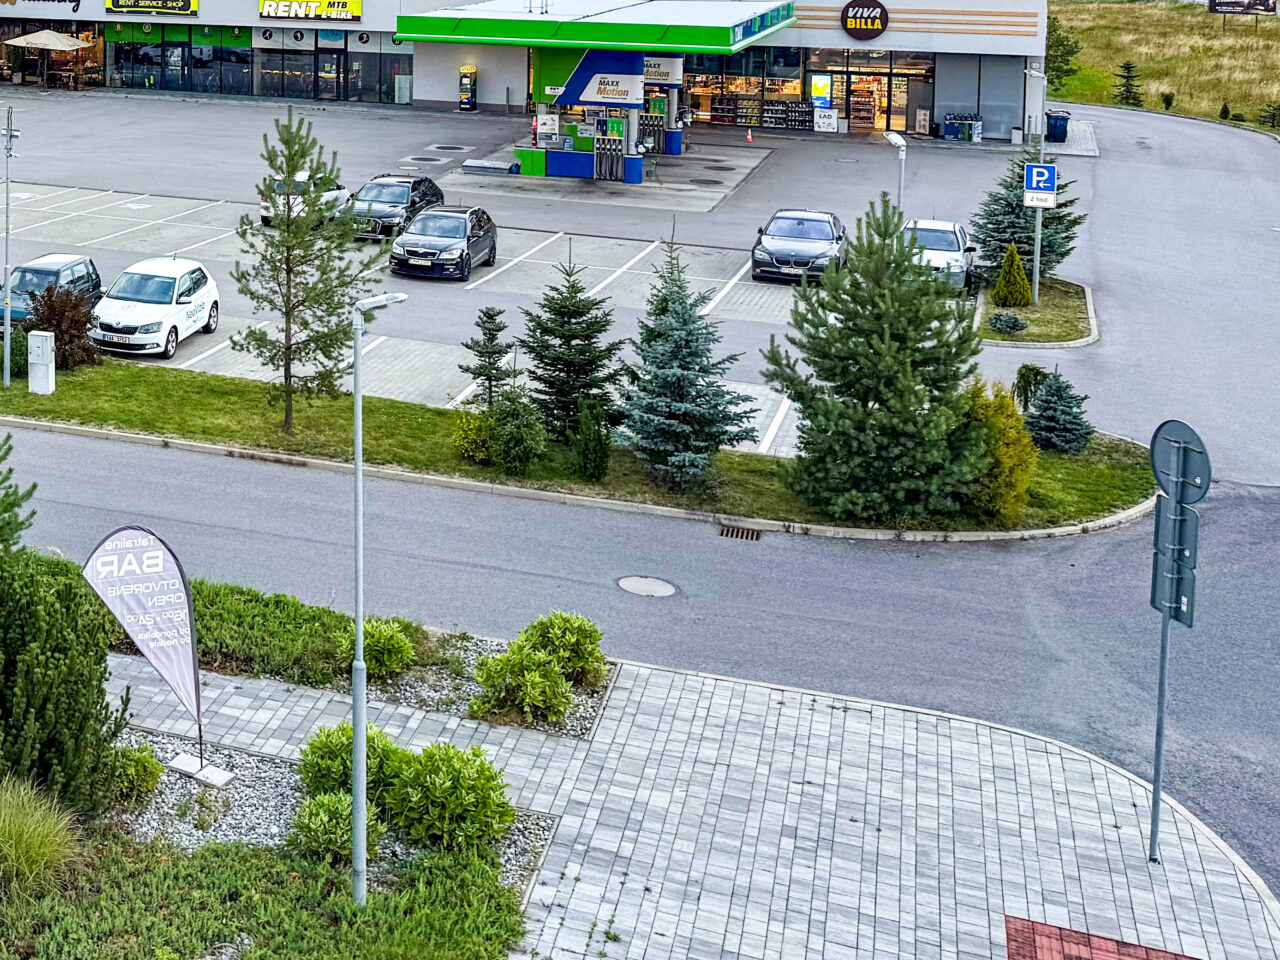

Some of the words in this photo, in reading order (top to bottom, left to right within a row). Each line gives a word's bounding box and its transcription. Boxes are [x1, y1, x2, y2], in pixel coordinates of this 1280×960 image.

[261, 0, 321, 18] RENT
[327, 1, 348, 9] MTB
[320, 10, 353, 19] E-BIKE
[847, 6, 882, 18] VIVA
[846, 18, 882, 29] BILLA
[596, 86, 629, 97] Motion
[1032, 167, 1049, 188] P
